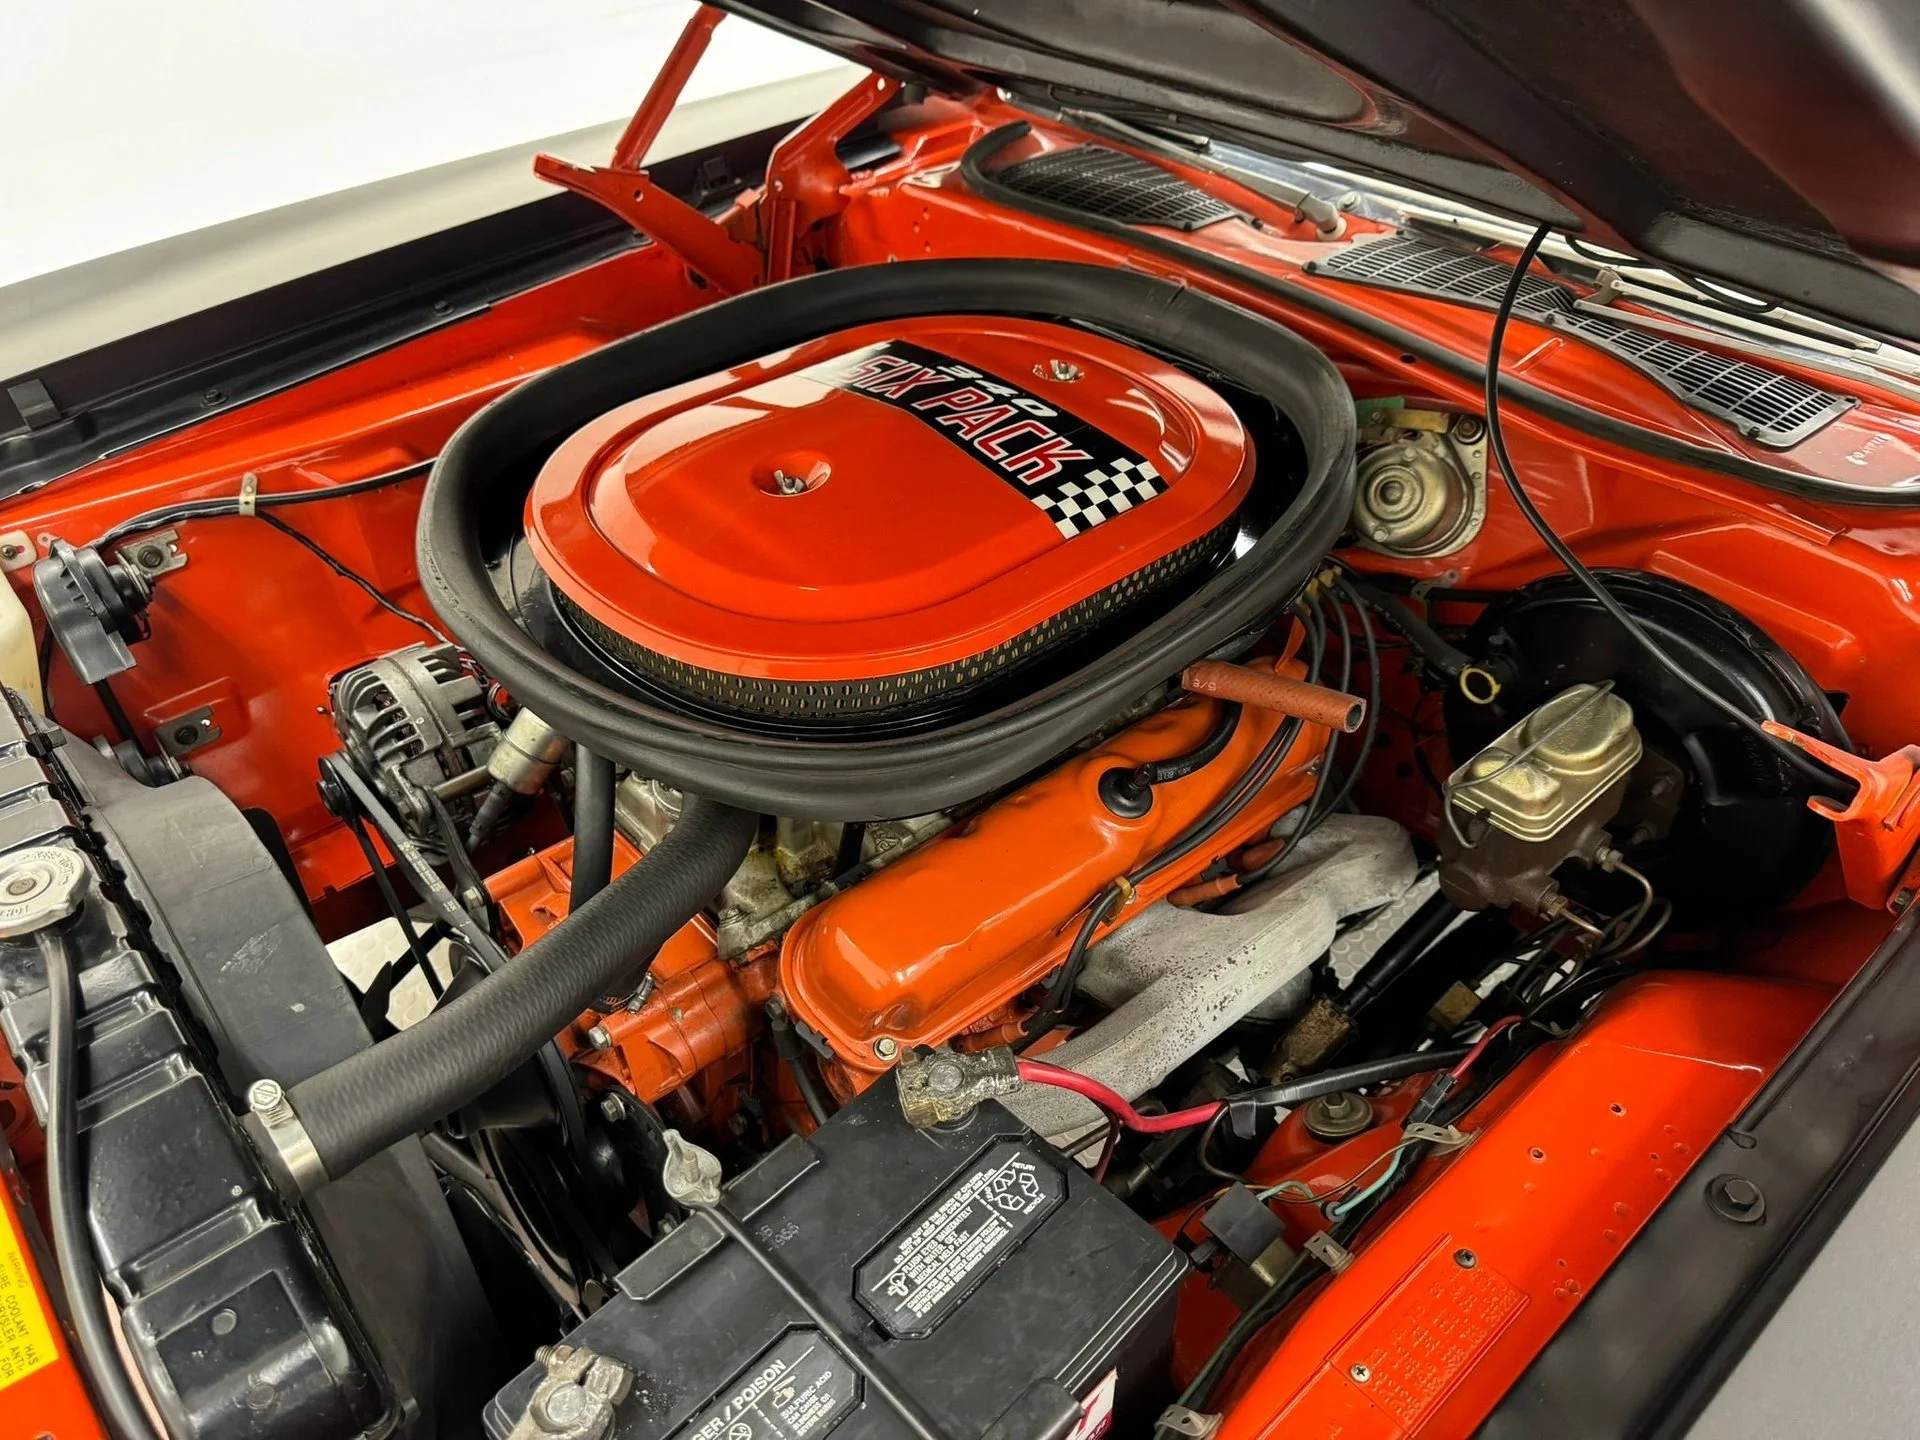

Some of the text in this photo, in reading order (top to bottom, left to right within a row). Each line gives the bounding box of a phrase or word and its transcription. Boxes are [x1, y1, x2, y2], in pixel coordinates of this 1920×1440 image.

[937, 365, 1058, 417] 340
[841, 354, 1095, 486] SIX PACK
[894, 1254, 903, 1263] DO
[902, 1244, 913, 1256] NOT
[972, 1179, 983, 1190] AND
[1023, 1193, 1046, 1215] RECYCLE
[901, 1206, 973, 1273] FLUSH EYES IMMEDIATELY
[911, 1227, 923, 1238] OUT
[980, 1219, 998, 1237] FOLLOW
[907, 1262, 925, 1279] WITH
[944, 1231, 958, 1244] GET
[914, 1230, 970, 1284] MEDICAL HELP FAST
[948, 1259, 967, 1277] VEHICLE
[920, 1301, 932, 1313] NOT
[6, 1294, 29, 1337] COOLANT
[24, 1344, 39, 1366] HAS
[1, 1357, 15, 1377] FOR
[732, 1359, 787, 1410] POISON
[781, 1370, 833, 1419] SULFURIC ACID
[787, 1394, 819, 1424] CAN CAUSE
[820, 1392, 832, 1403] OR
[797, 1398, 837, 1437] SEVERE BURNS
